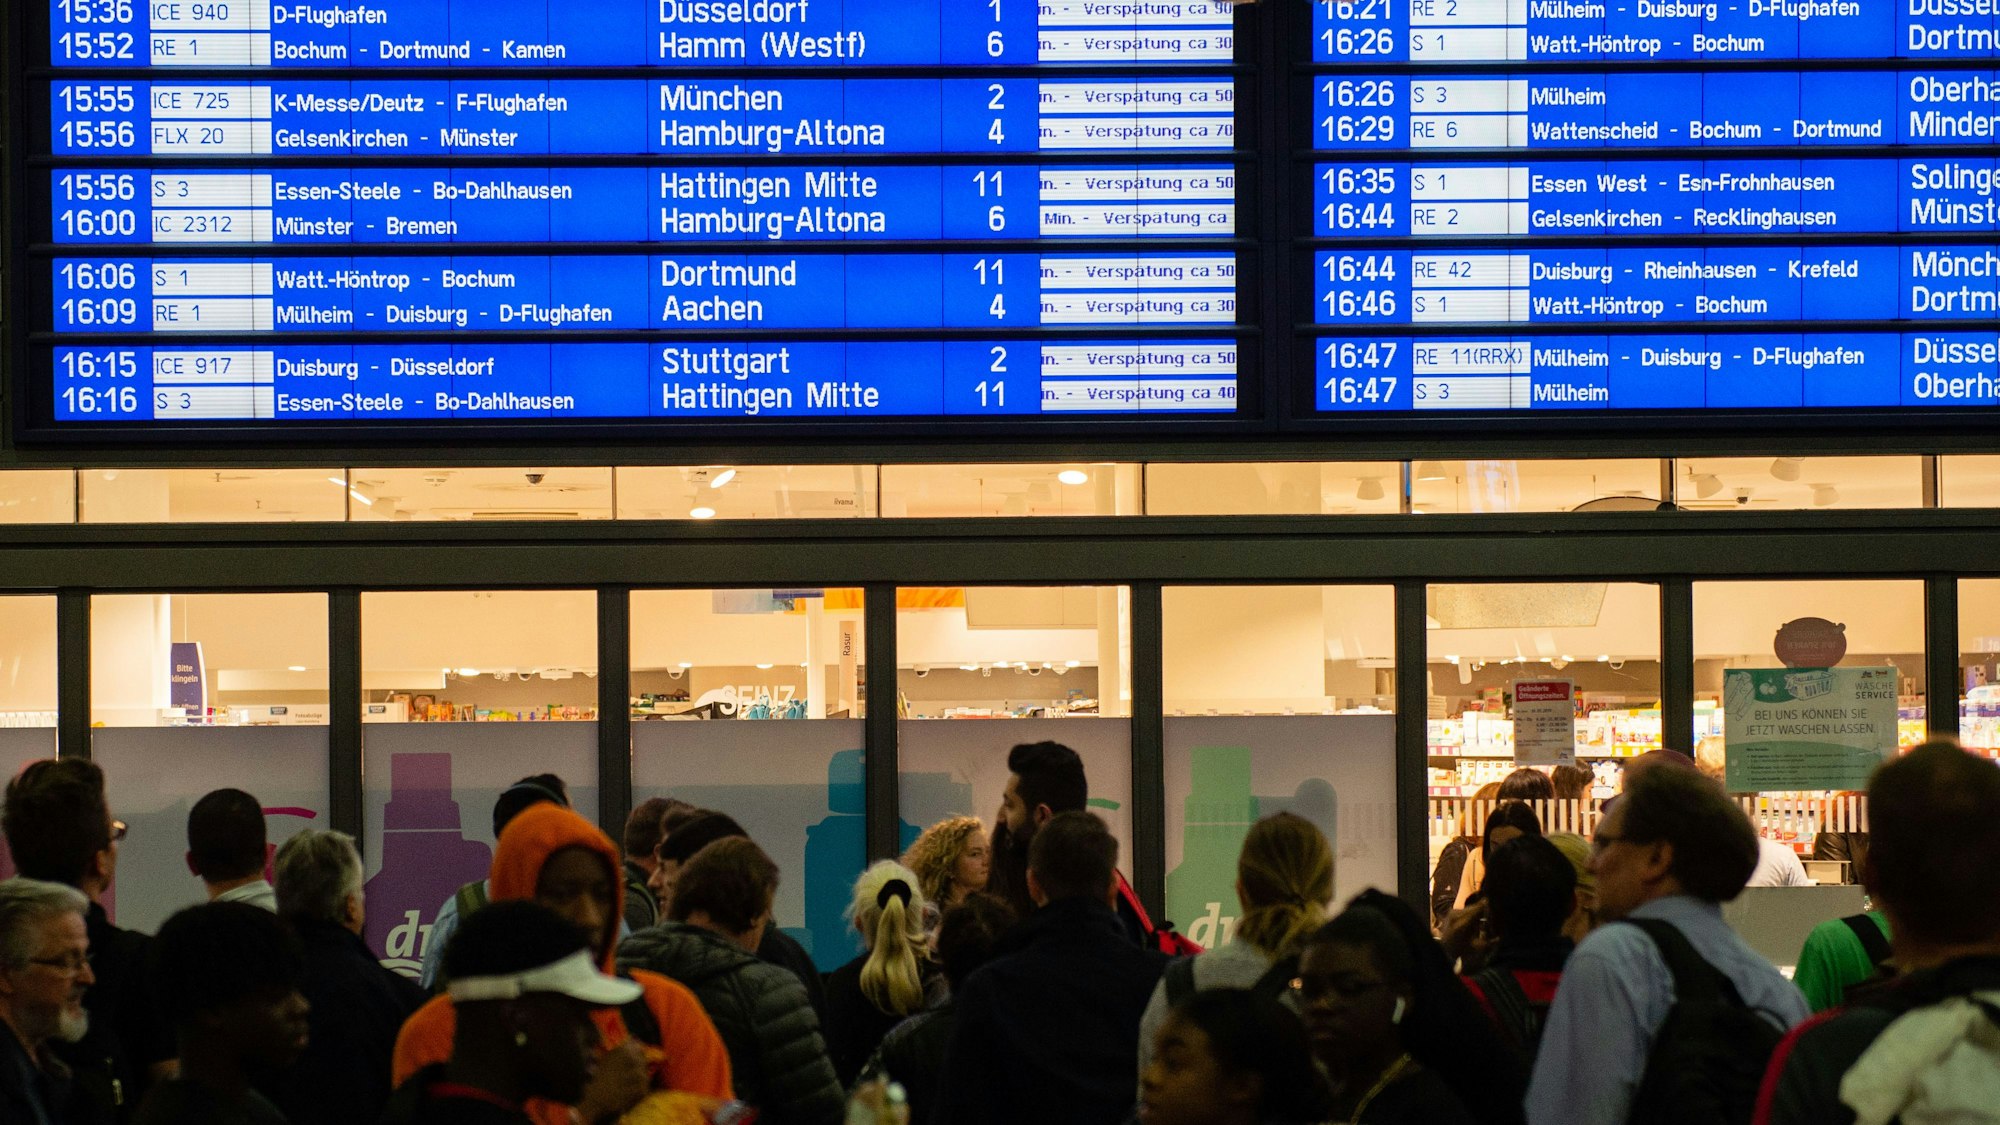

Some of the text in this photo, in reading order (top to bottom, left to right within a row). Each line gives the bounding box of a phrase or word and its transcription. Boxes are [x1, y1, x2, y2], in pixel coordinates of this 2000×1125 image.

[58, 0, 1000, 28] 15:36 ICE 940 D-Flughafen Düsseldorf 1
[1413, 0, 1859, 21] RE 2 Mülheim Duisburg D-Flughafen
[59, 31, 1003, 58] 15:52 RE 1 Bochum Dortmund Kamen Hamm (Westf) 6
[1321, 29, 1764, 56] 16:26 S 1 Watt.-Höntrop Bochum
[60, 84, 1004, 116] 15:55 ICE 725 K-Messe/Deutz F-Flughafen München 2
[1322, 81, 1605, 106] 16:26 S 3 Mülheim
[60, 119, 1233, 152] 15:56 FLX 20 Gelsenkirchen Münster Hamburg-Altona 4 Verspätung ca 70
[1322, 116, 1881, 141] 16:29 RE 6 Wattenscheid Bochum Dortmund
[60, 171, 1002, 204] 15:56 S 3 Essen-Steele Bo-Dahlhausen Hattingen Mitte 11
[1323, 168, 1834, 194] 16:35 S 1 Essen West Esn-Frohnhausen
[61, 206, 1227, 239] 16:00 IC 2312 Münster Bremen Hamburg-Altona 6 Min. Verspätung ca
[1322, 203, 1836, 229] 16:44 RE 2 Gelsenkirchen Recklinghausen
[61, 259, 1002, 292] 16:06 S 1 Watt.-Höntrop Bochum Dortmund 11
[1323, 256, 1858, 284] 16:44 RE 42 Duisburg Rheinhausen Krefeld
[62, 294, 1006, 326] 16:09 RE 1 Mülheim Duisburg D-Flughafen Aachen 4
[1323, 290, 1767, 318] 16:46 S 1 Watt.-Höntrop Bochum
[62, 347, 1006, 380] 16:15 ICE 917 Duisburg Düsseldorf Stuttgart 2
[1324, 343, 1864, 369] 16:47 RE 11(RRX) Mülheim Duisburg D-Flughafen
[63, 381, 1003, 415] 16:16 S 3 Essen-Steele Bo-Dahlhausen Hattingen Mitte 11
[1324, 377, 1608, 403] 16:47 S 3 Mülheim
[842, 632, 852, 656] Rasur
[171, 674, 199, 684] klingeln
[176, 664, 193, 673] Bitte
[1855, 691, 1894, 700] SERVICE
[1754, 706, 1868, 721] BEI UNS KÖNNEN SIE
[1746, 725, 1775, 736] JETZT
[1779, 725, 1831, 735] WASCHEN
